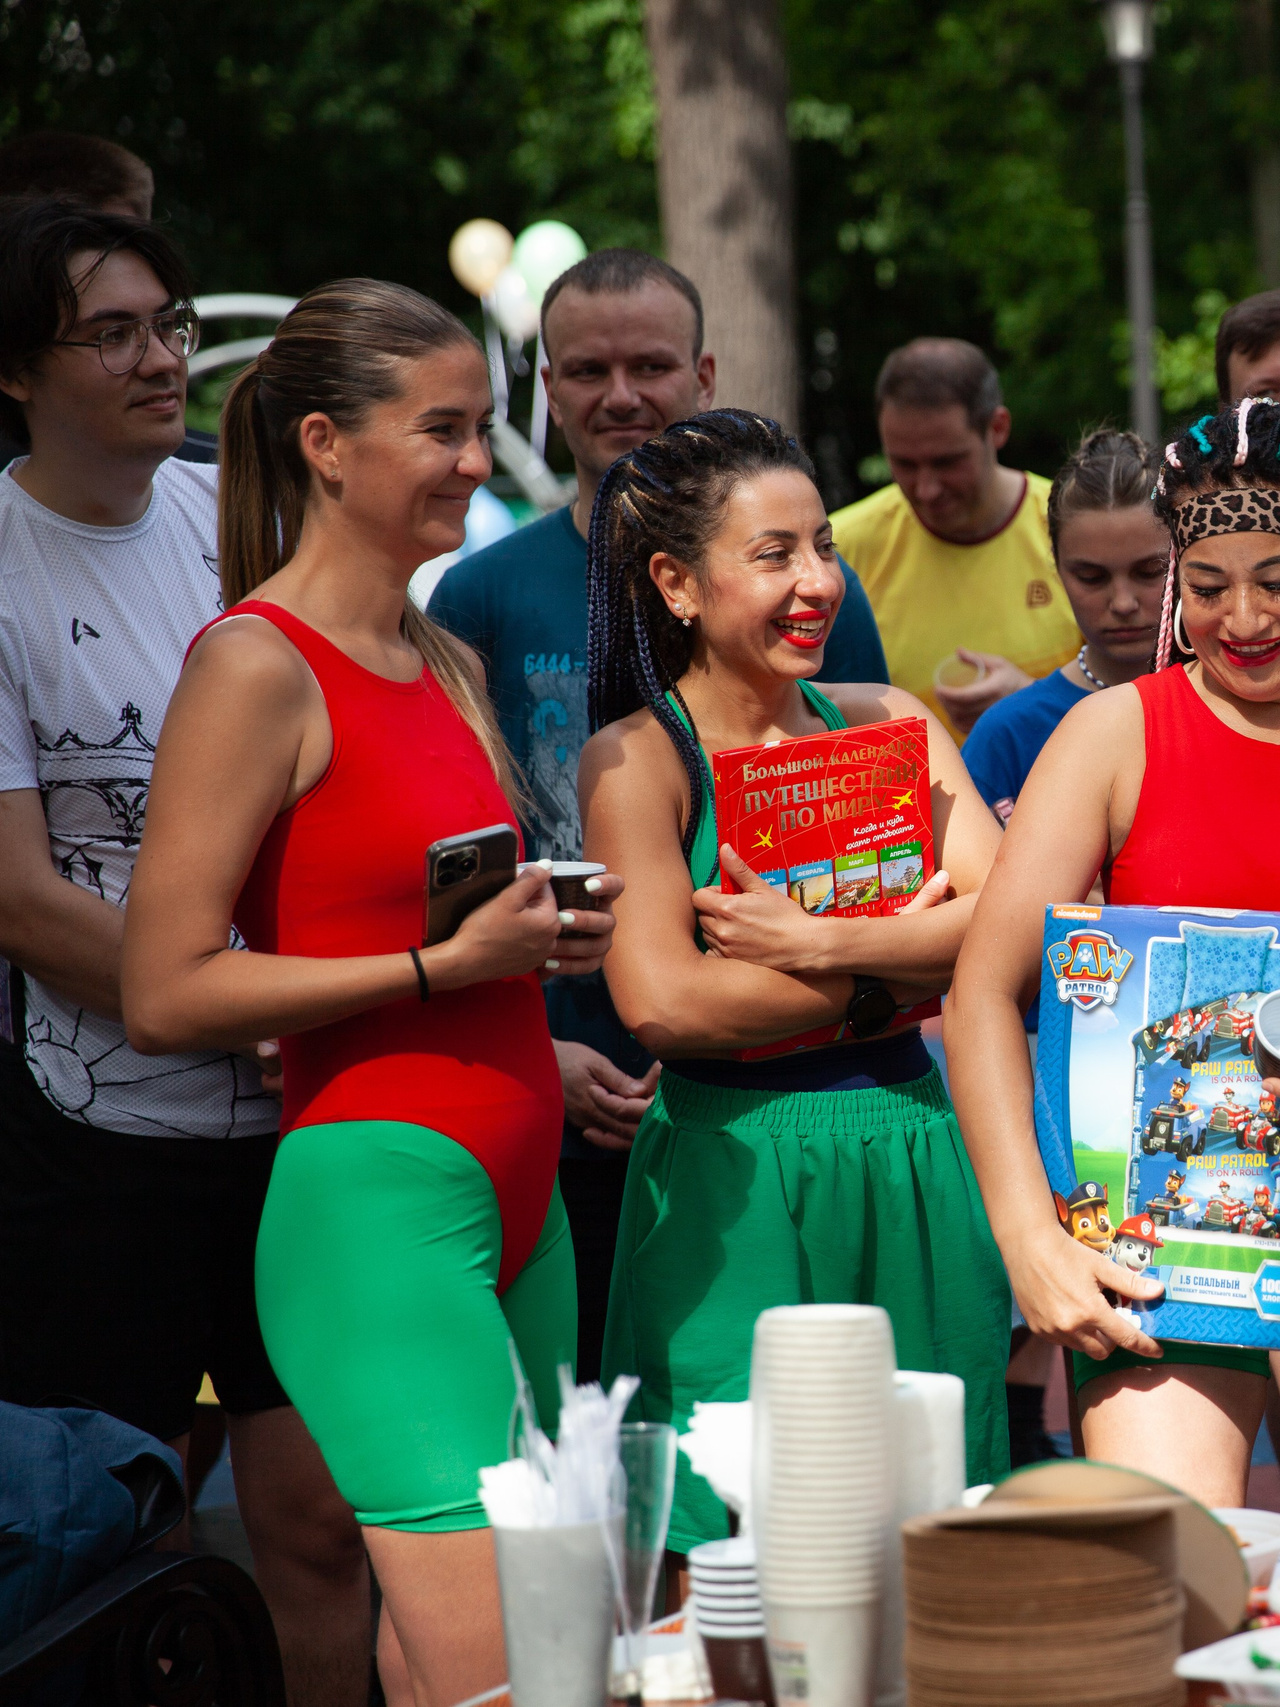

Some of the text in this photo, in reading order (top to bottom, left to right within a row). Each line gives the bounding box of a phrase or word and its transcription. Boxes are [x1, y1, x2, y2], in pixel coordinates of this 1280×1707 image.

[743, 739, 917, 782] БОЛЬШОЙ КАЛЕНДАРЬ
[744, 758, 918, 814] ПУТЕШЕСТВИЙ
[780, 792, 888, 832] ПО МИРУ
[853, 822, 878, 837] Когда
[886, 815, 905, 828] куда
[846, 824, 914, 850] ехать отдыхать
[890, 849, 912, 858] АПРЕЛЬ
[848, 858, 865, 867] МАРТ
[796, 867, 825, 877] ФЕВРАЛЬ
[1047, 941, 1134, 983] PAW
[1065, 983, 1109, 996] PATROL
[1191, 1059, 1259, 1077] PAW PATR
[1211, 1076, 1219, 1084] IS
[1221, 1076, 1234, 1084] ON
[1236, 1075, 1243, 1083] A
[1186, 1153, 1269, 1170] PAW PATROL
[1206, 1168, 1264, 1177] IS ON A ROLL!
[1180, 1274, 1240, 1290] 1.5 СПАЛЬНЫЙ
